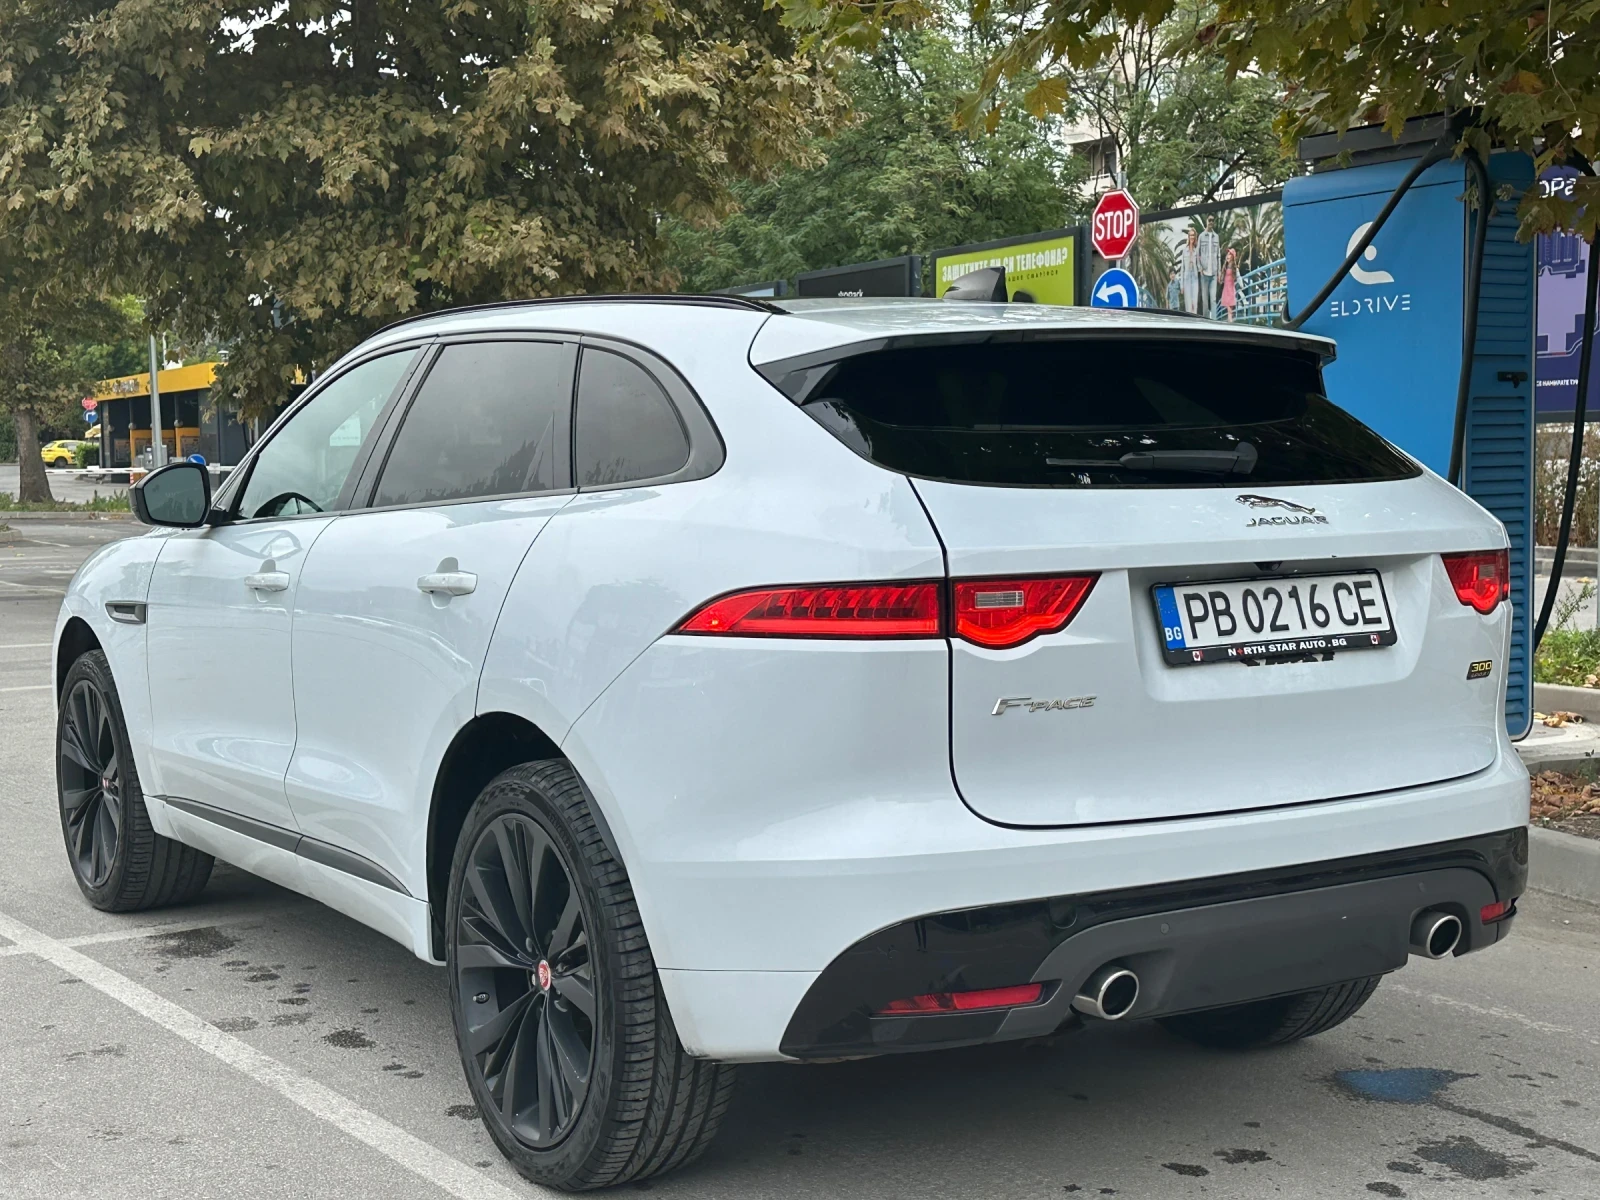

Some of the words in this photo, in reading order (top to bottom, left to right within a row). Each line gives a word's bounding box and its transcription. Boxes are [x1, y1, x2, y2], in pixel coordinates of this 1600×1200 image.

[1095, 208, 1133, 241] STOP
[1003, 256, 1014, 273] СИ
[1016, 248, 1068, 271] ТЕЛЕФОНА?
[1330, 294, 1411, 317] ELDRIVE
[1246, 516, 1329, 527] JAGUAR
[1182, 590, 1237, 640] PB
[1242, 583, 1330, 634] 0216
[1332, 580, 1383, 627] CE
[1164, 626, 1183, 642] BG
[1268, 642, 1296, 653] STAR
[1471, 662, 1491, 672] 300
[991, 696, 1098, 716] F-PACE
